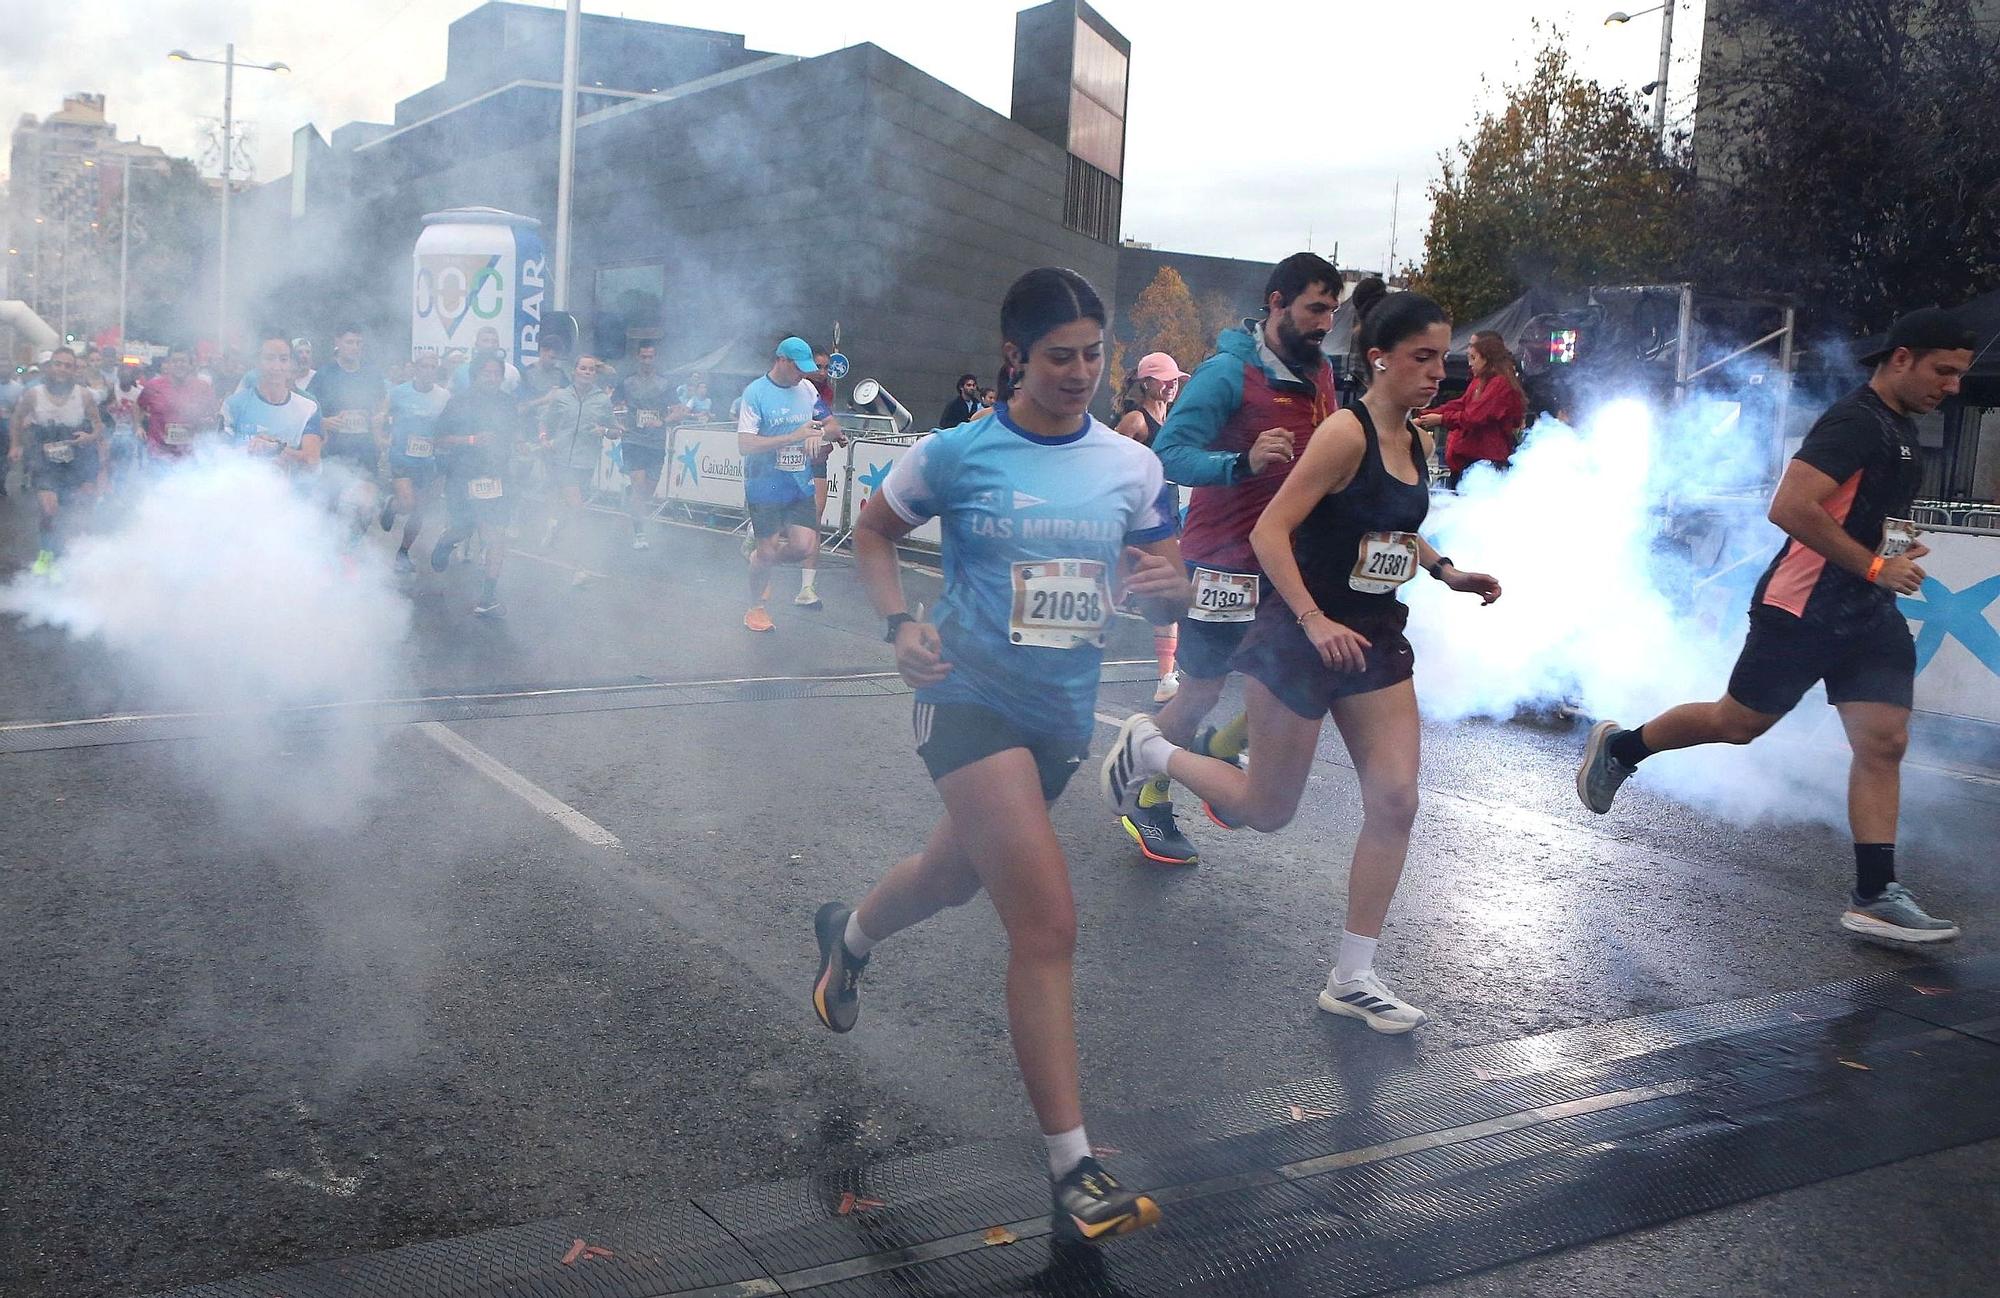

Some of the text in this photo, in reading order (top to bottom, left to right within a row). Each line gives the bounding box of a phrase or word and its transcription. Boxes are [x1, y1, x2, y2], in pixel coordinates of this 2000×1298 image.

[701, 455, 743, 477] CaixaBank
[972, 513, 1014, 539] LAS
[1368, 551, 1408, 577] 21381
[1031, 590, 1101, 622] 21038
[1201, 588, 1245, 608] 21397
